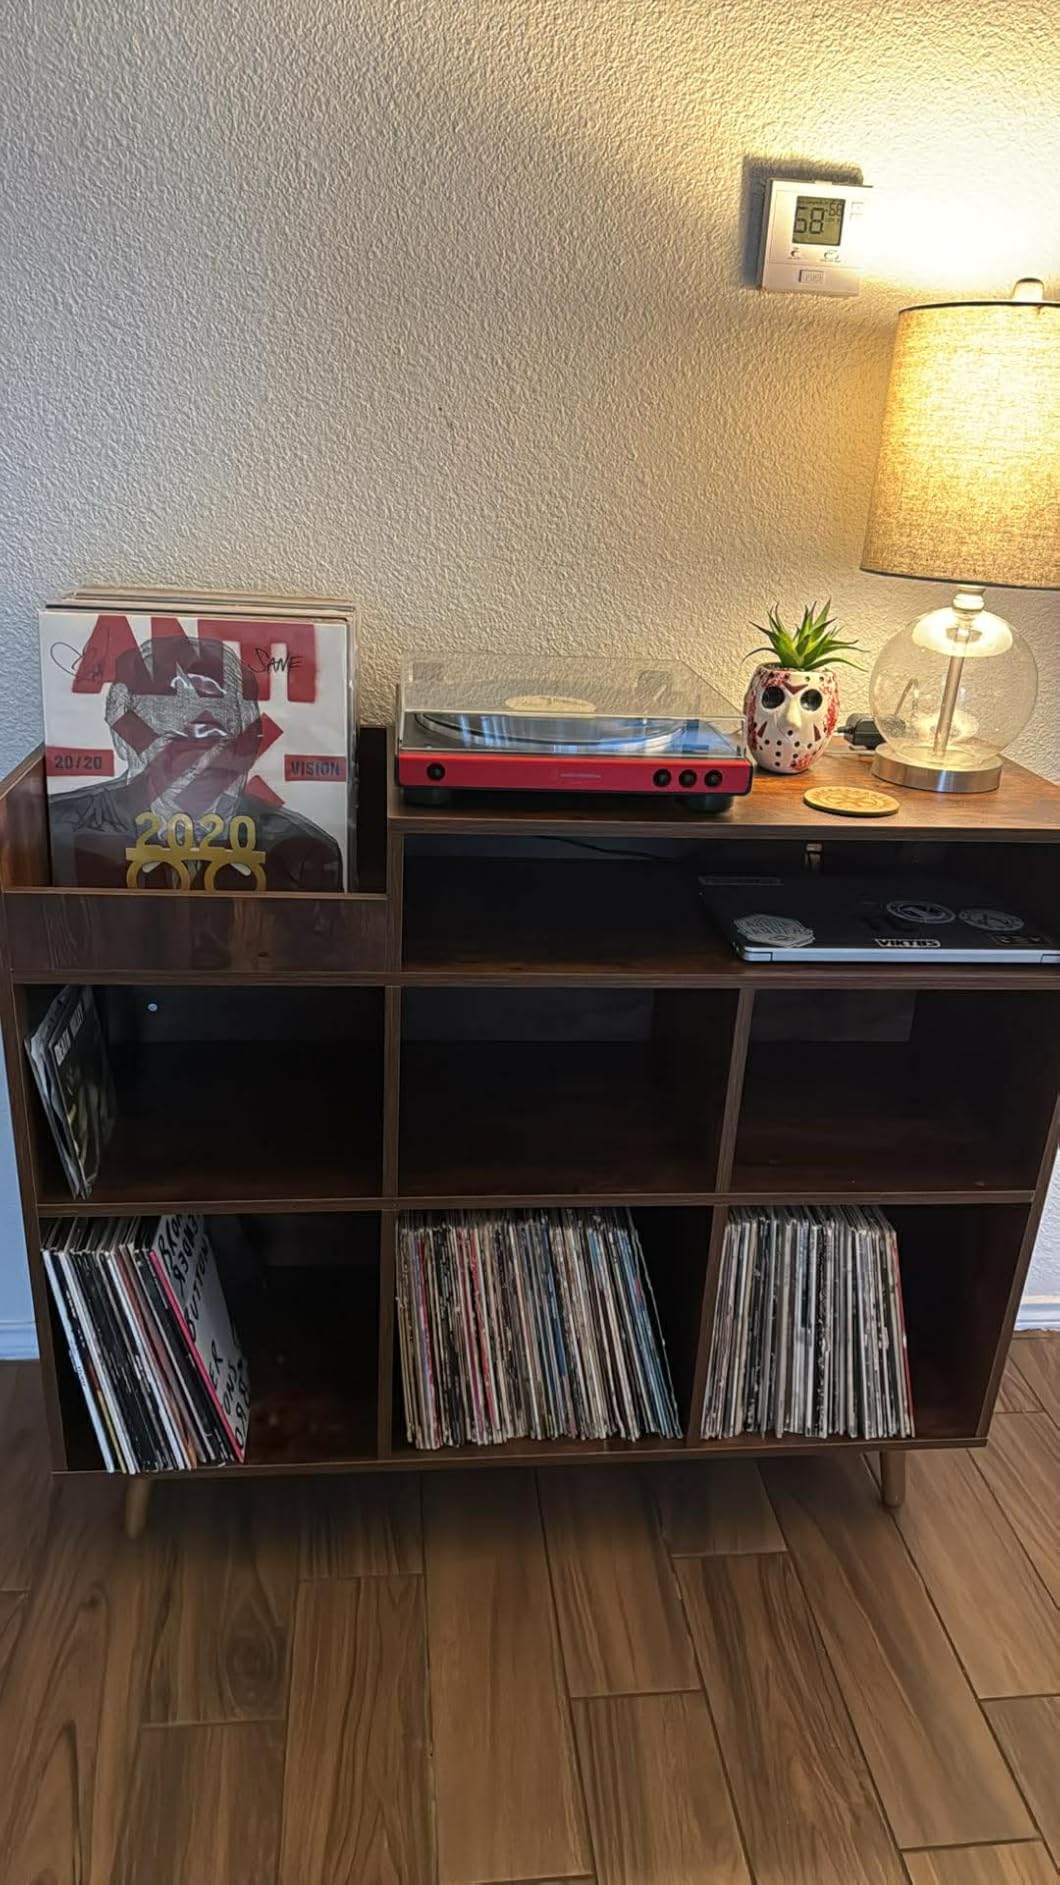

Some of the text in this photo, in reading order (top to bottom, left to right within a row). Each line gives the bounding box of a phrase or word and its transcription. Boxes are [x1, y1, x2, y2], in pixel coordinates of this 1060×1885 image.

[794, 206, 825, 234] 68
[71, 615, 317, 703] ANTI
[54, 755, 104, 770] 20/20
[290, 760, 341, 776] VISION
[135, 812, 257, 850] 2020
